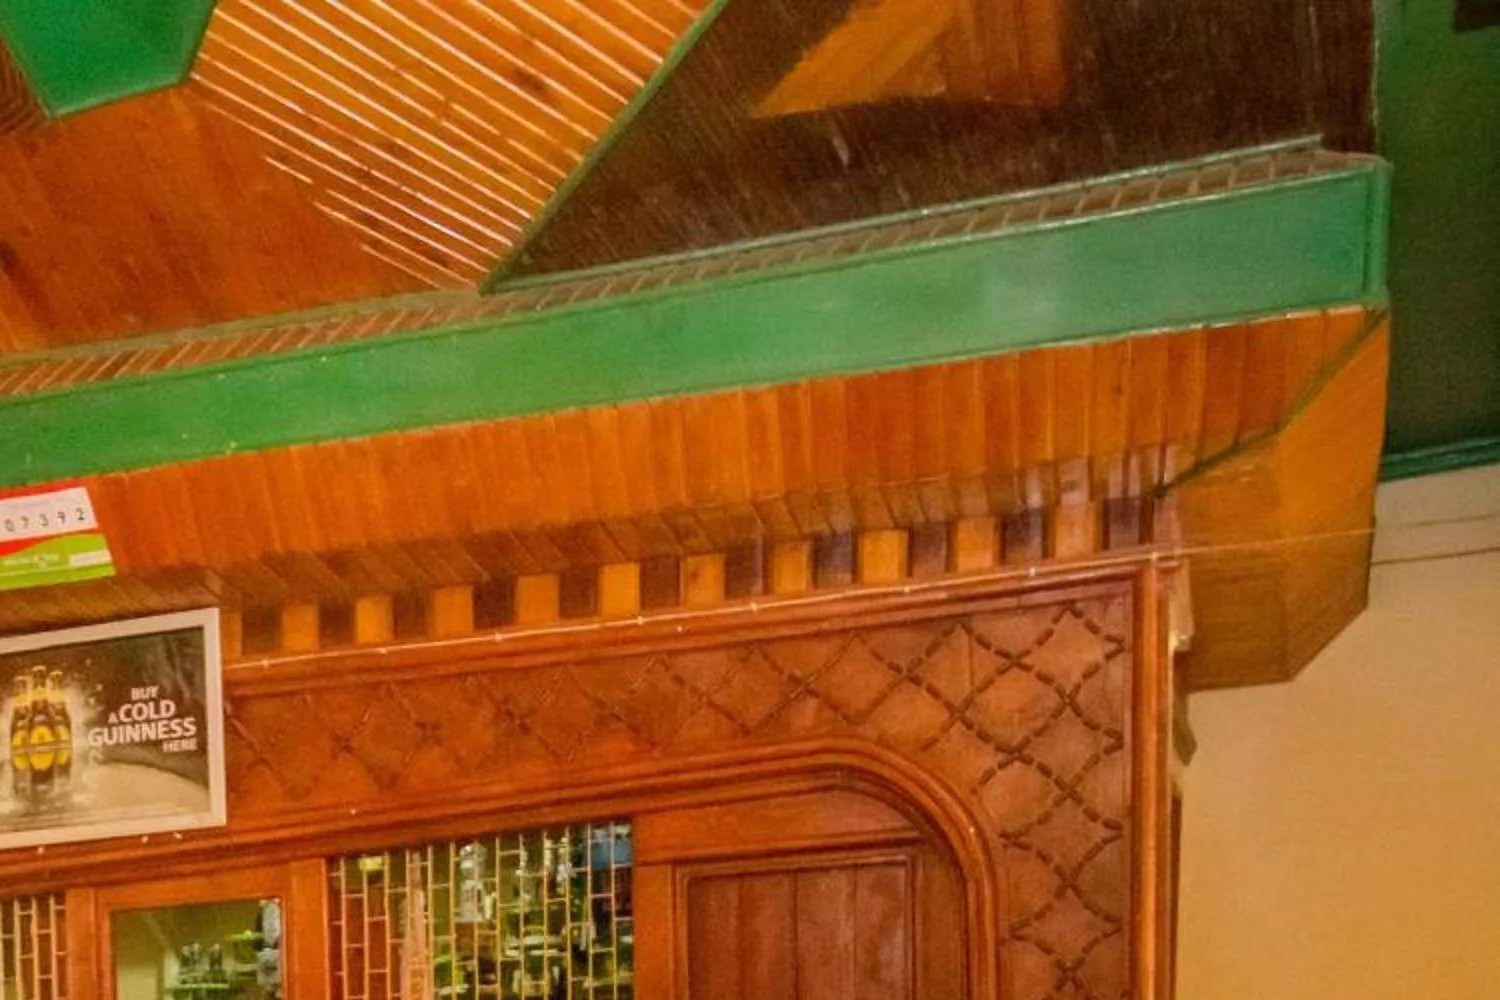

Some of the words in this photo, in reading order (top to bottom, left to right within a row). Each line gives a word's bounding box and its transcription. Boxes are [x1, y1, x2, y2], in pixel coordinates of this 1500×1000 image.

[131, 685, 159, 701] BUY
[108, 711, 119, 724] A
[119, 699, 176, 723] COLD
[87, 716, 197, 747] GUINNESS
[162, 738, 197, 752] HERE
